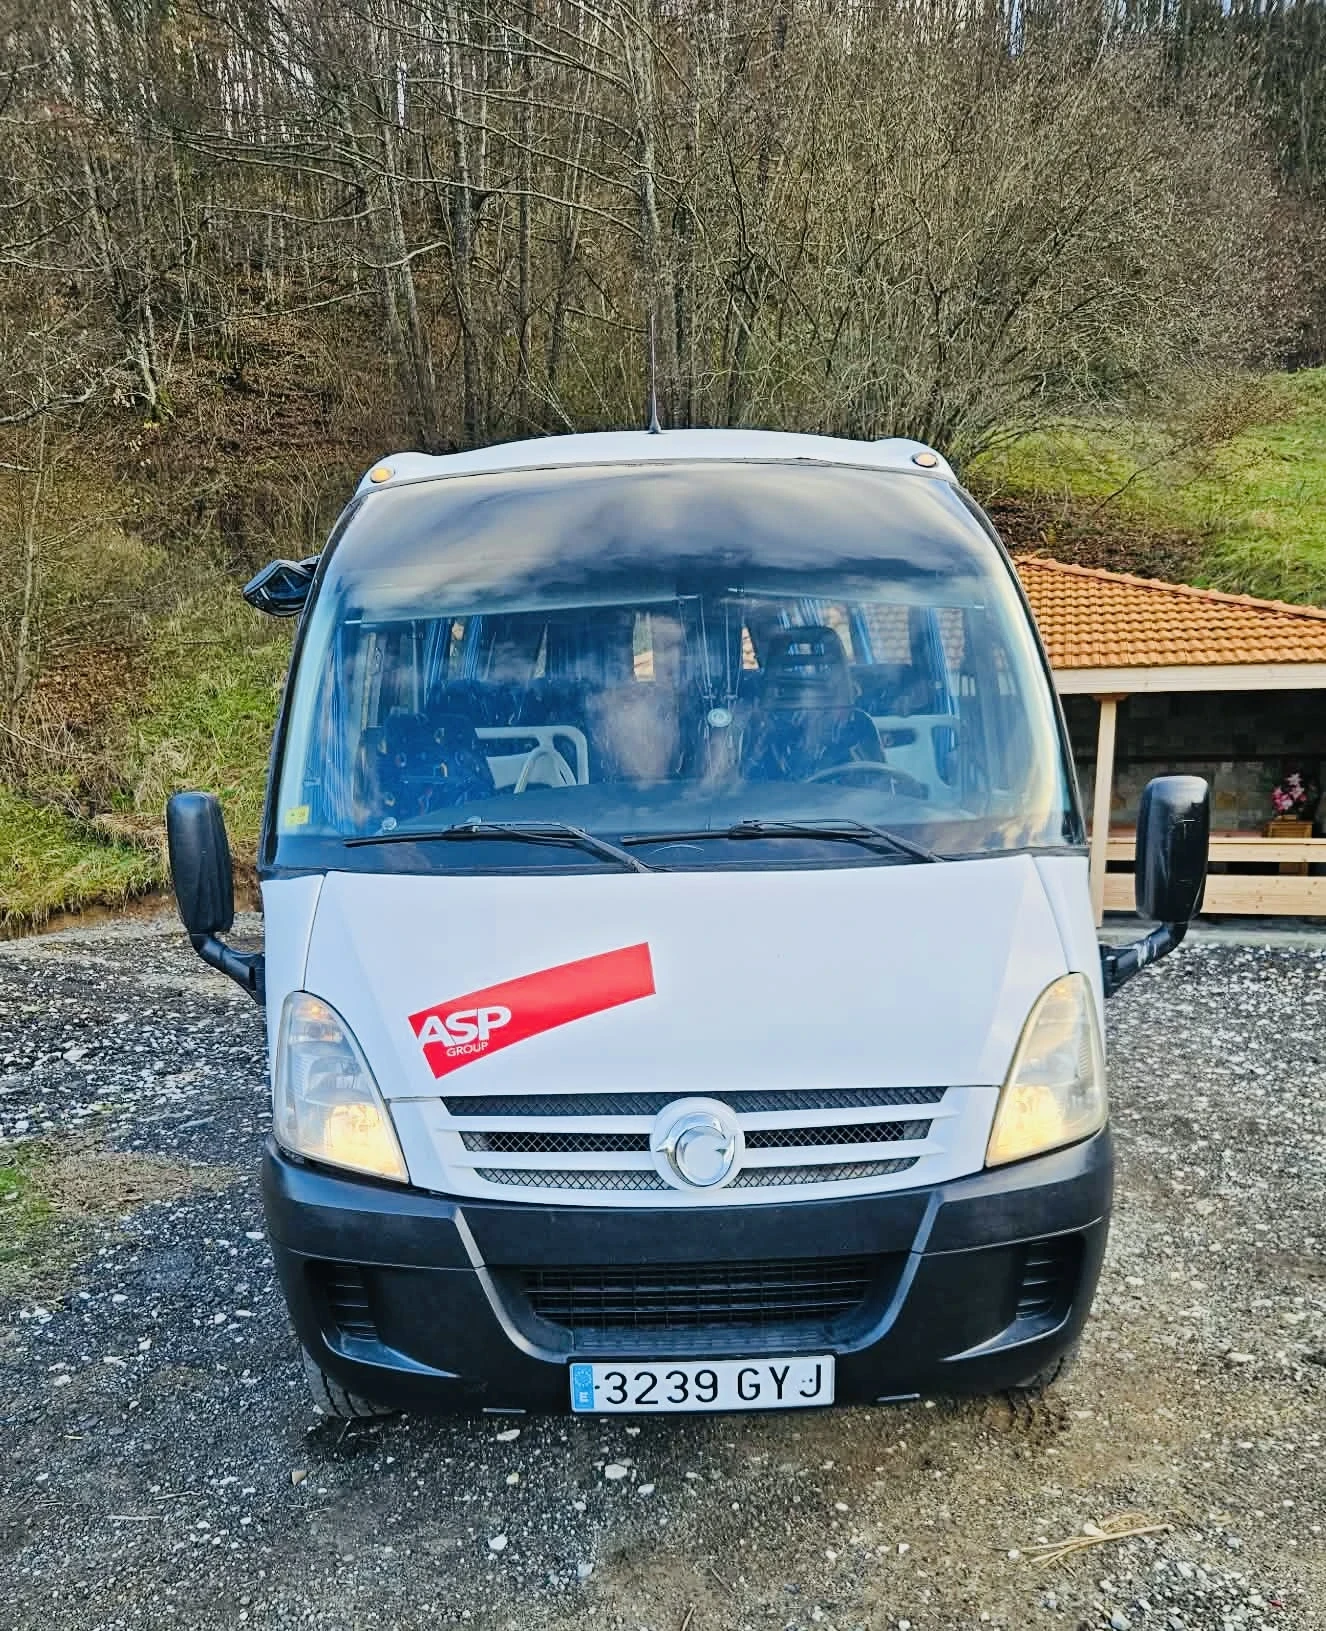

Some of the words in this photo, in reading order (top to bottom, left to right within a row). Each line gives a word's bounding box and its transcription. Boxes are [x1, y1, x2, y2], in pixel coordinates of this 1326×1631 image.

[418, 1005, 512, 1047] ASP
[446, 1041, 489, 1057] GROUP
[579, 1391, 590, 1404] E
[603, 1369, 719, 1405] 3239
[737, 1364, 822, 1400] GYJ
